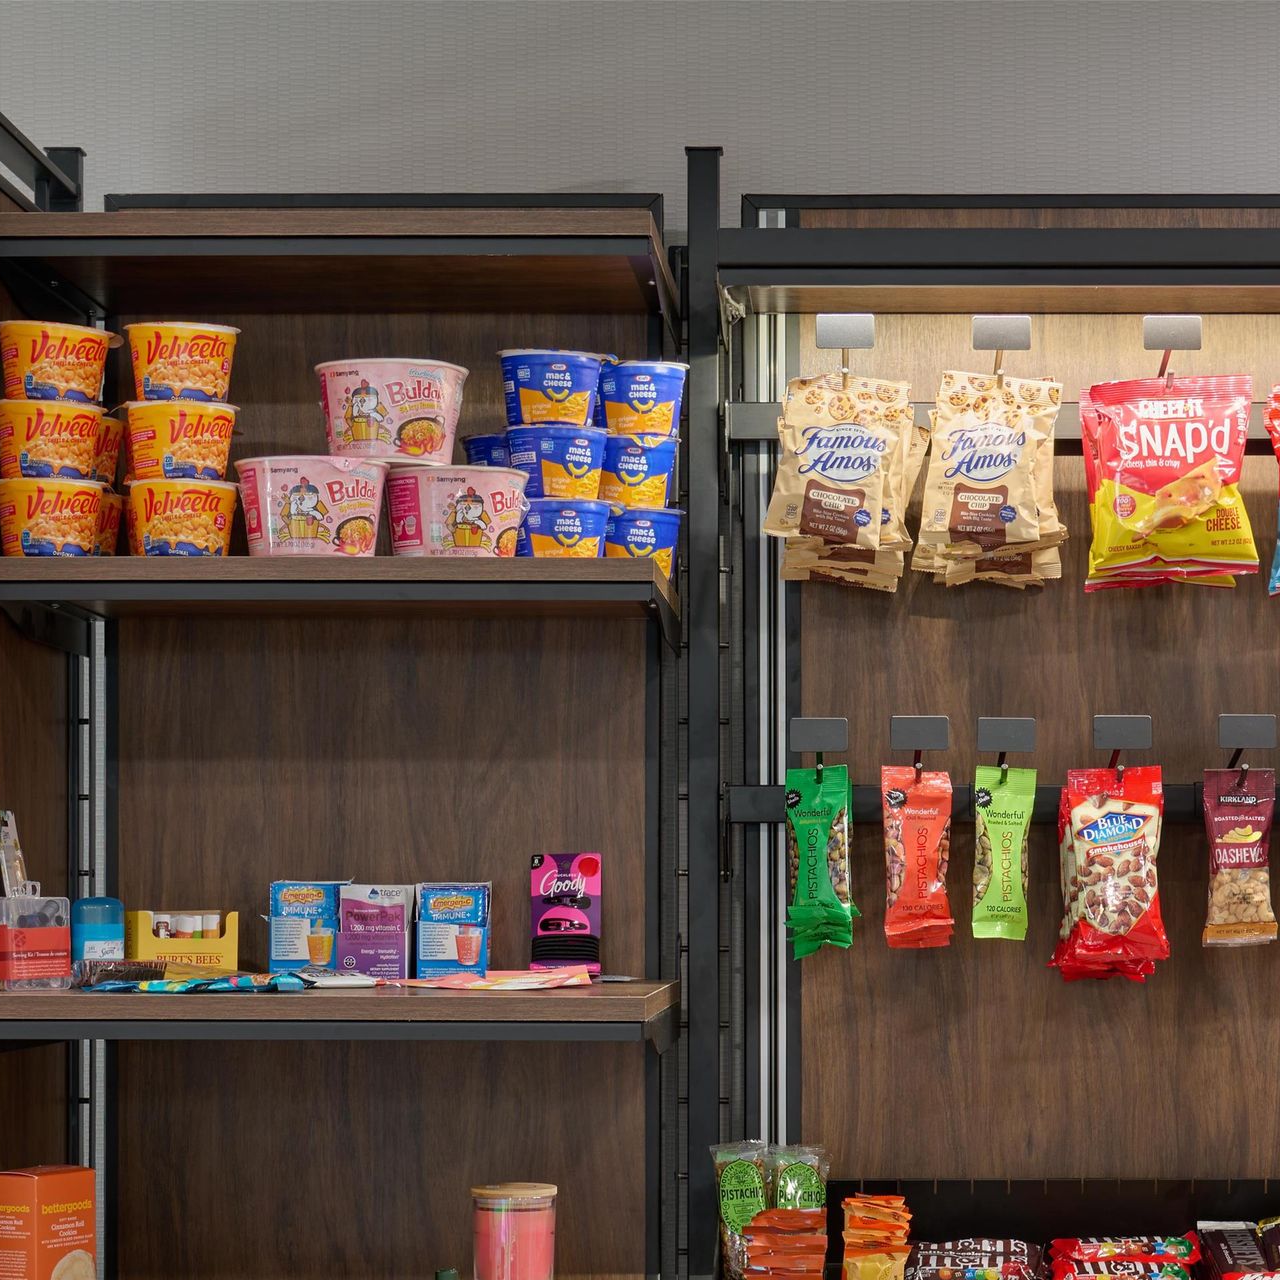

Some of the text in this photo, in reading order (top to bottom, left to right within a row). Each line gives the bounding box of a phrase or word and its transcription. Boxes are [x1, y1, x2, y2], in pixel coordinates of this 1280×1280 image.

[31, 330, 106, 364] Velveeta
[147, 331, 227, 365] Velveeta
[26, 408, 101, 442] Velveeta
[170, 410, 234, 444] Velveeta
[795, 424, 887, 456] Famous
[942, 429, 1026, 460] Famous
[798, 450, 876, 475] Amos
[944, 451, 1017, 479] Amos
[27, 486, 100, 520] Velveeta
[144, 488, 220, 522] Velveeta
[812, 491, 857, 506] CHOCOLATE
[824, 501, 842, 509] CHIP
[959, 494, 1001, 502] CHOCOLATE
[1216, 507, 1239, 518] DOUBLE
[1206, 517, 1241, 532] CHEESE
[986, 809, 1024, 819] Wonderful
[1098, 814, 1126, 829] BLUE
[1083, 818, 1144, 841] DIAMOND
[1089, 839, 1143, 856] Smokehouse
[807, 828, 819, 899] PISTACHIOS
[918, 827, 929, 899] PISTACHIOS
[1003, 831, 1013, 902] PISTACHIOS
[380, 888, 401, 898] trace
[540, 870, 586, 898] Goody
[345, 911, 401, 923] PowerPak
[375, 924, 396, 932] vitamin
[156, 954, 222, 965] BURT'S BEES
[41, 1199, 93, 1215] bettergoods
[51, 1222, 74, 1231] Cinnamon
